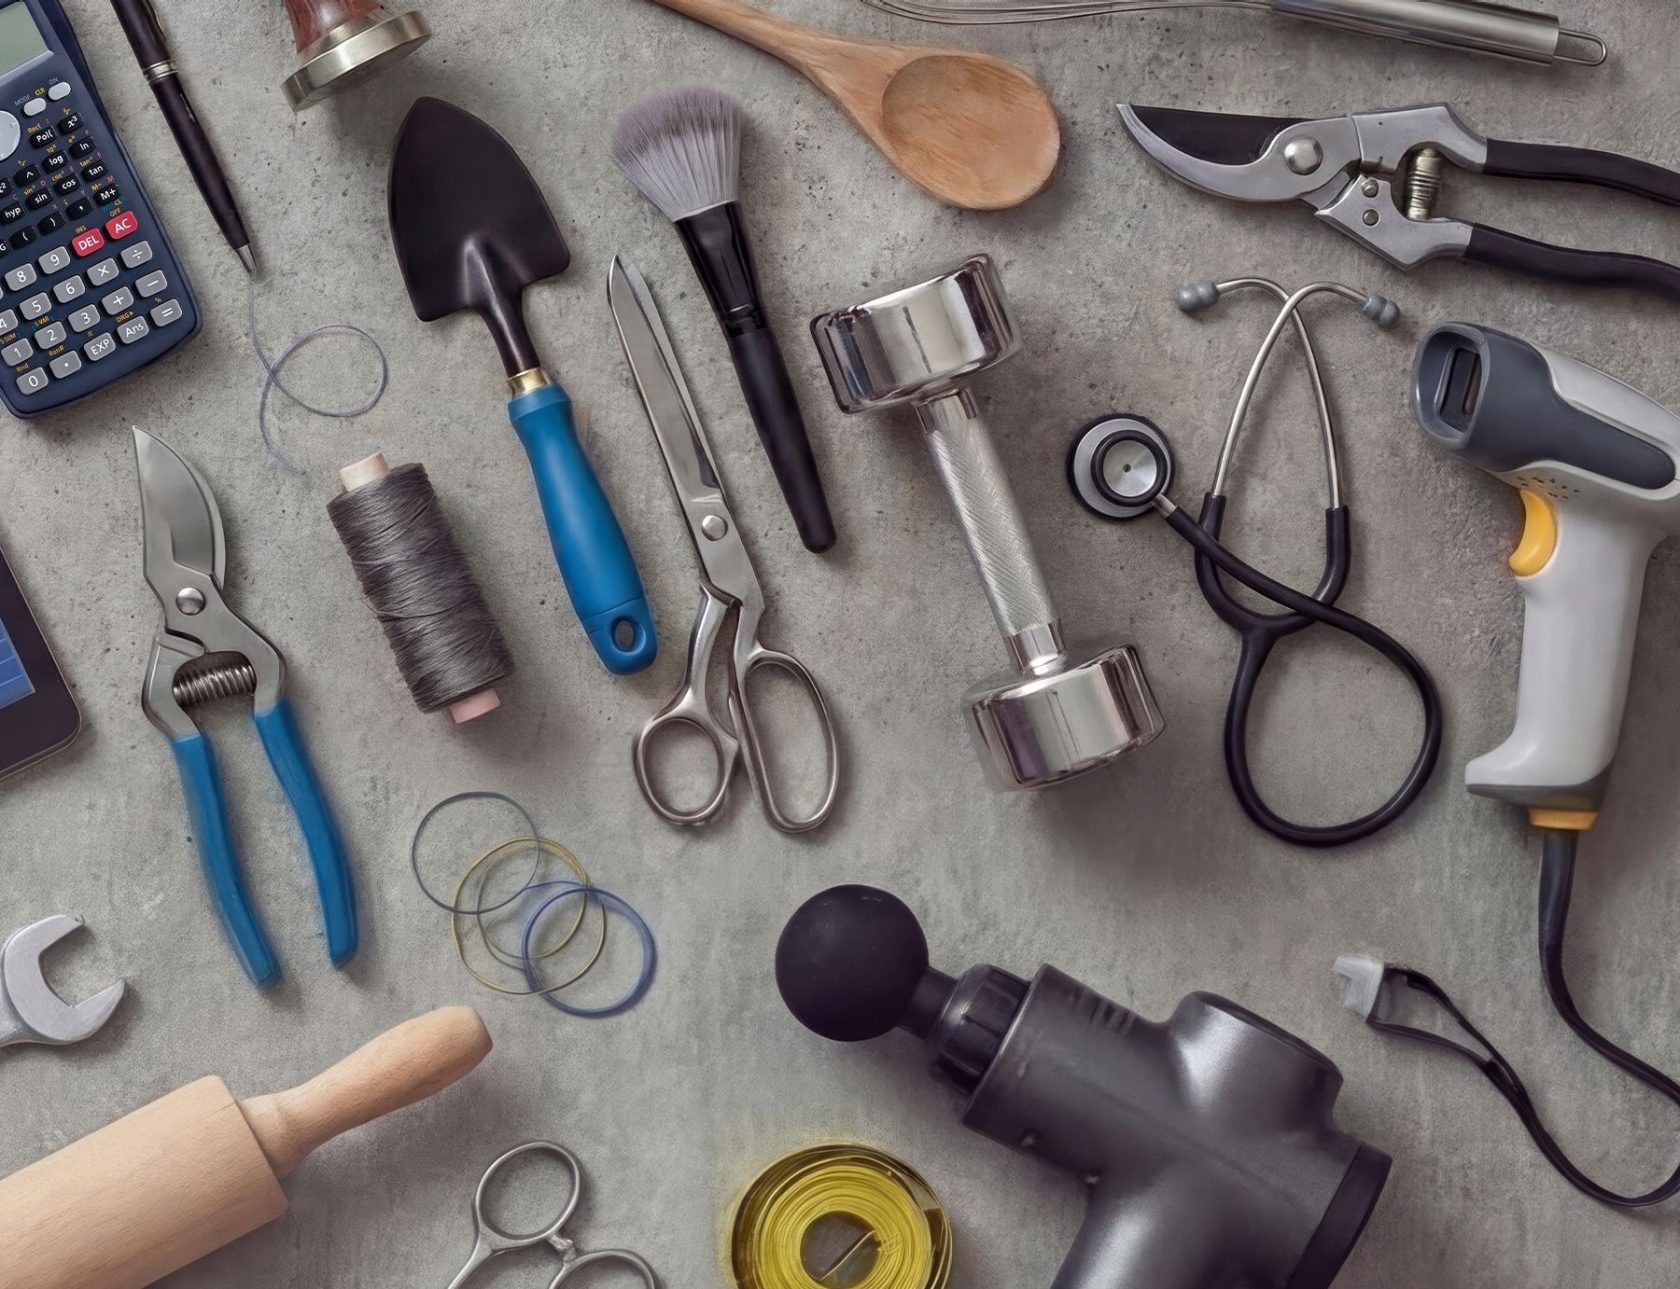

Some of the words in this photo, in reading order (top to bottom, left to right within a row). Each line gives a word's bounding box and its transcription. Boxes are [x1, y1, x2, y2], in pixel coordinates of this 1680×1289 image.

[80, 143, 89, 151] ln
[49, 155, 64, 166] log
[89, 165, 103, 176] tan
[62, 179, 76, 190] cos
[34, 194, 48, 204] sin
[100, 188, 116, 200] M+
[4, 207, 21, 218] hyp
[115, 218, 131, 234] AC
[78, 235, 100, 250] DEL
[50, 254, 60, 266] 9
[16, 270, 27, 283] 8
[66, 283, 75, 295] 6
[31, 300, 42, 313] 5
[0, 318, 8, 329] 4
[80, 312, 91, 325] 3
[47, 329, 57, 342] 2
[126, 323, 144, 338] Ans
[14, 348, 22, 358] 1
[90, 338, 110, 356] EXP
[28, 375, 39, 387] 0
